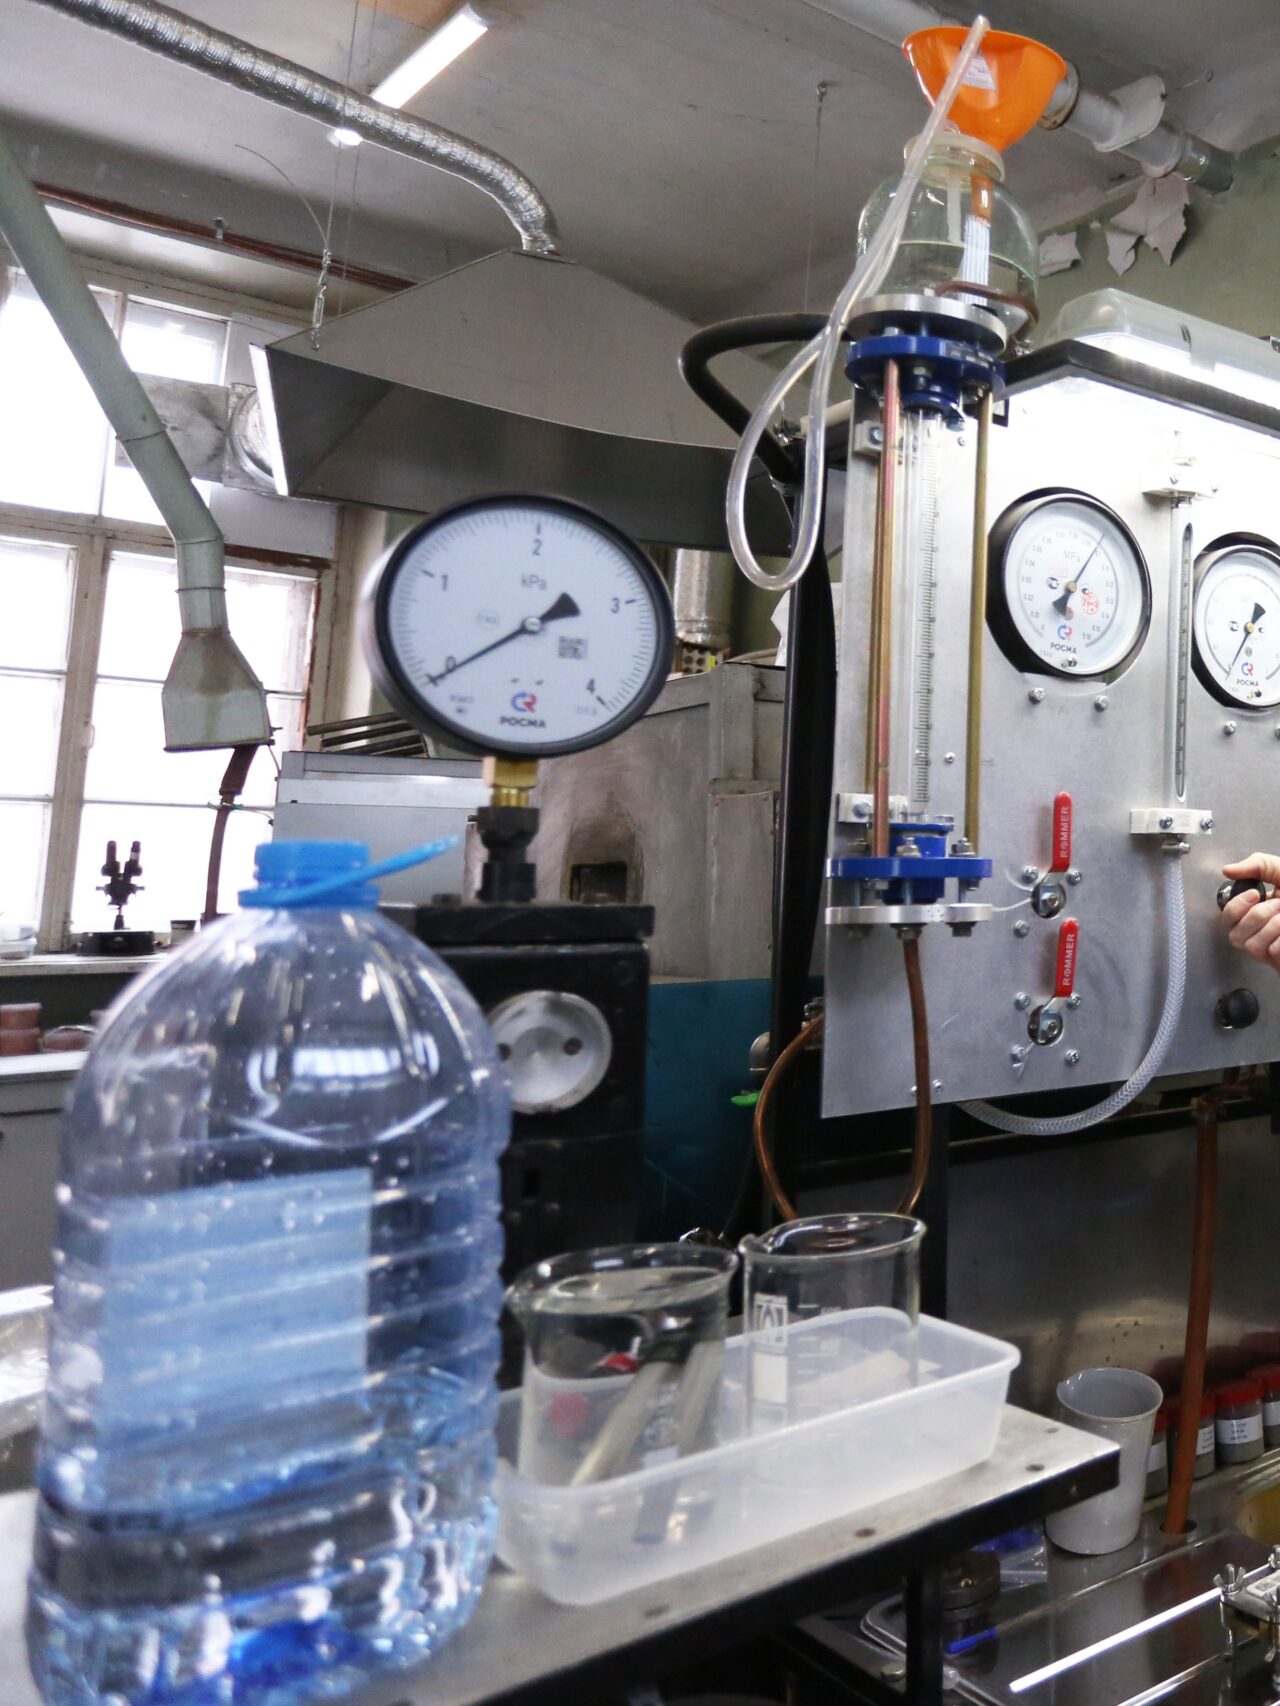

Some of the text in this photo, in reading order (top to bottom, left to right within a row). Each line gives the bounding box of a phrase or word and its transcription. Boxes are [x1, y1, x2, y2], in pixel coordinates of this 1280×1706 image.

[532, 539, 542, 556] 2
[442, 575, 448, 591] 1
[521, 575, 547, 591] kPa
[611, 597, 620, 614] 3
[1050, 642, 1077, 654] РОСМА
[586, 678, 596, 694] 4
[500, 716, 546, 728] РОСМА
[1060, 806, 1070, 859] ROMMER
[1062, 933, 1075, 986] ROMMER
